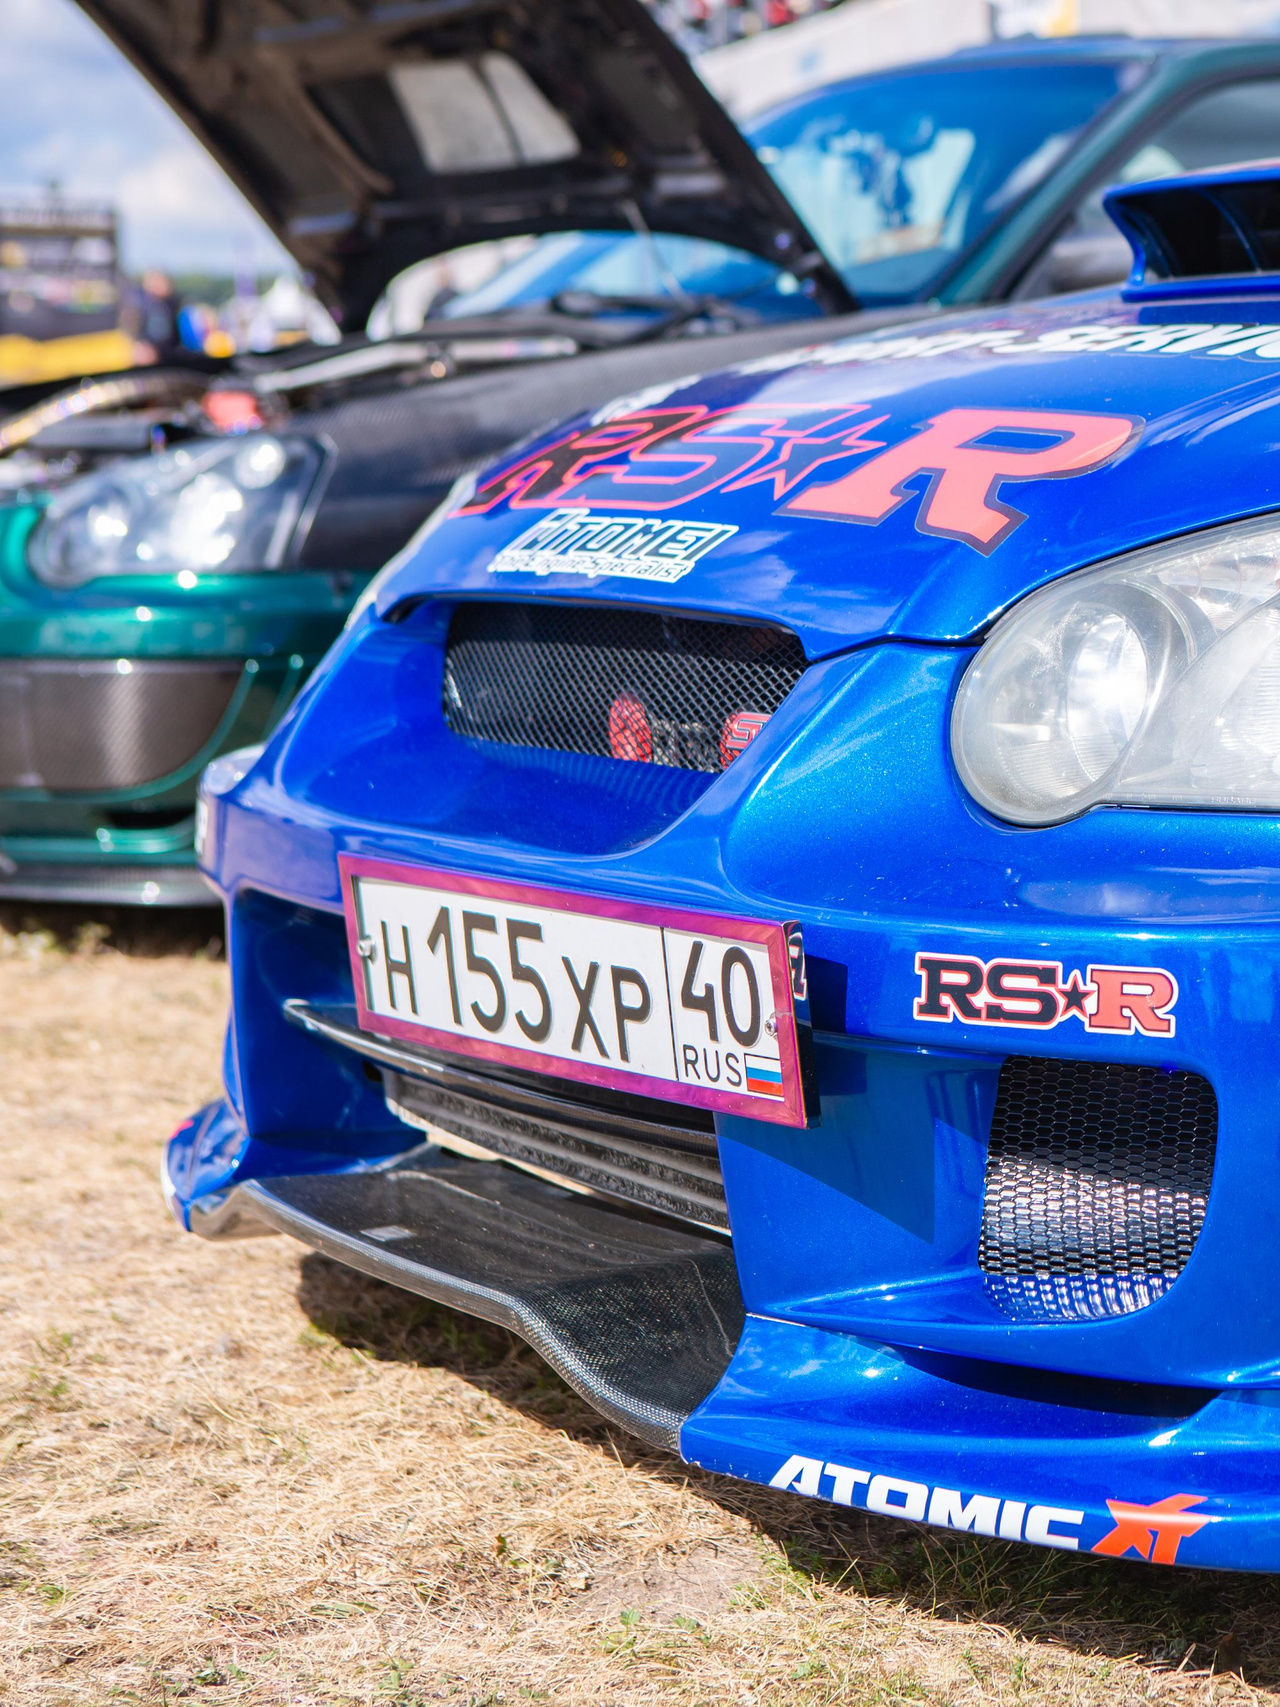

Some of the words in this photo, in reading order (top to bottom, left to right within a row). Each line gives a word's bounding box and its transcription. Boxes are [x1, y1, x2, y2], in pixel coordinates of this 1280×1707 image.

[681, 940, 761, 1048] 40
[683, 1044, 743, 1087] RUS
[768, 1454, 1085, 1550] ATOMIC
[1090, 1493, 1212, 1565] XT
